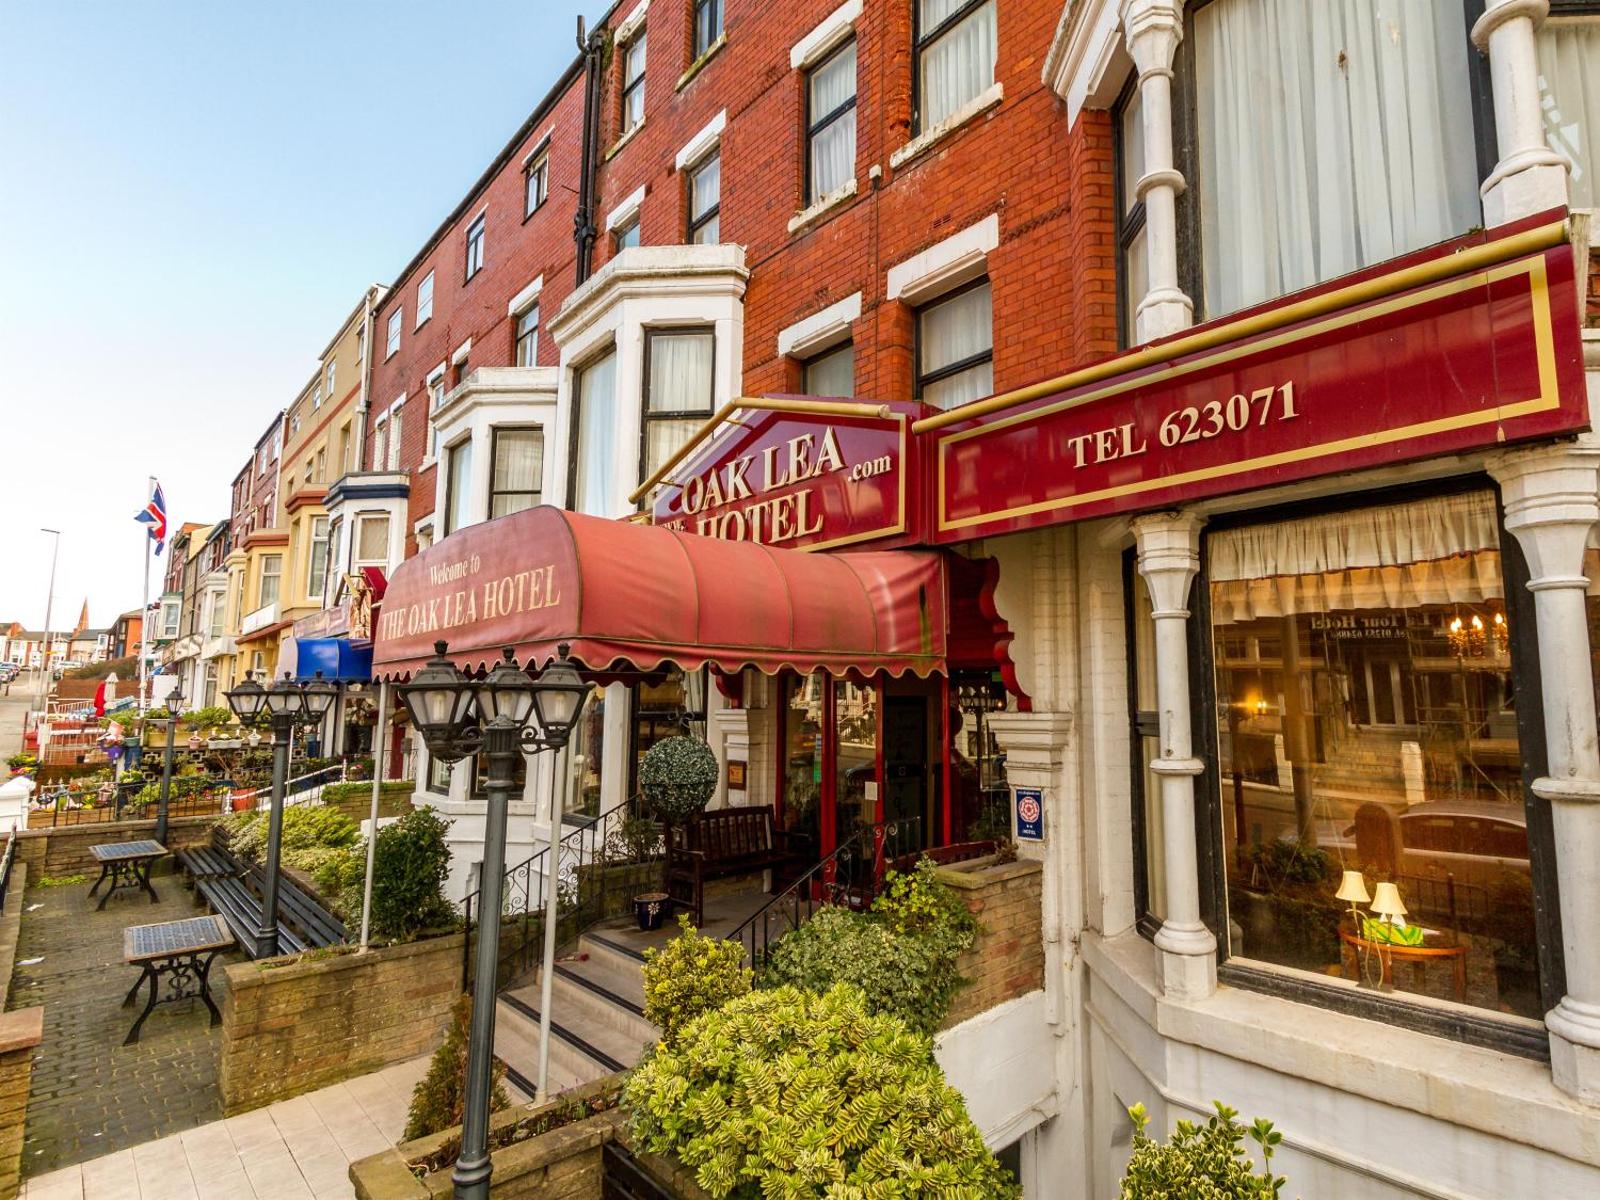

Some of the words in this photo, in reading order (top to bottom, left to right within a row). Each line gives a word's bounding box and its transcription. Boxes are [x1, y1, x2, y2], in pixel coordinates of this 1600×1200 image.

[1068, 423, 1147, 468] TEL
[1159, 380, 1299, 447] 623071
[681, 454, 757, 515] OAK
[762, 425, 848, 492] LEA
[847, 454, 892, 482] .com
[381, 608, 407, 642] THE
[408, 598, 441, 636] OAK
[443, 589, 478, 629] LEA
[482, 565, 561, 620] HOTEL
[430, 561, 468, 586] Welcome
[470, 554, 481, 575] to
